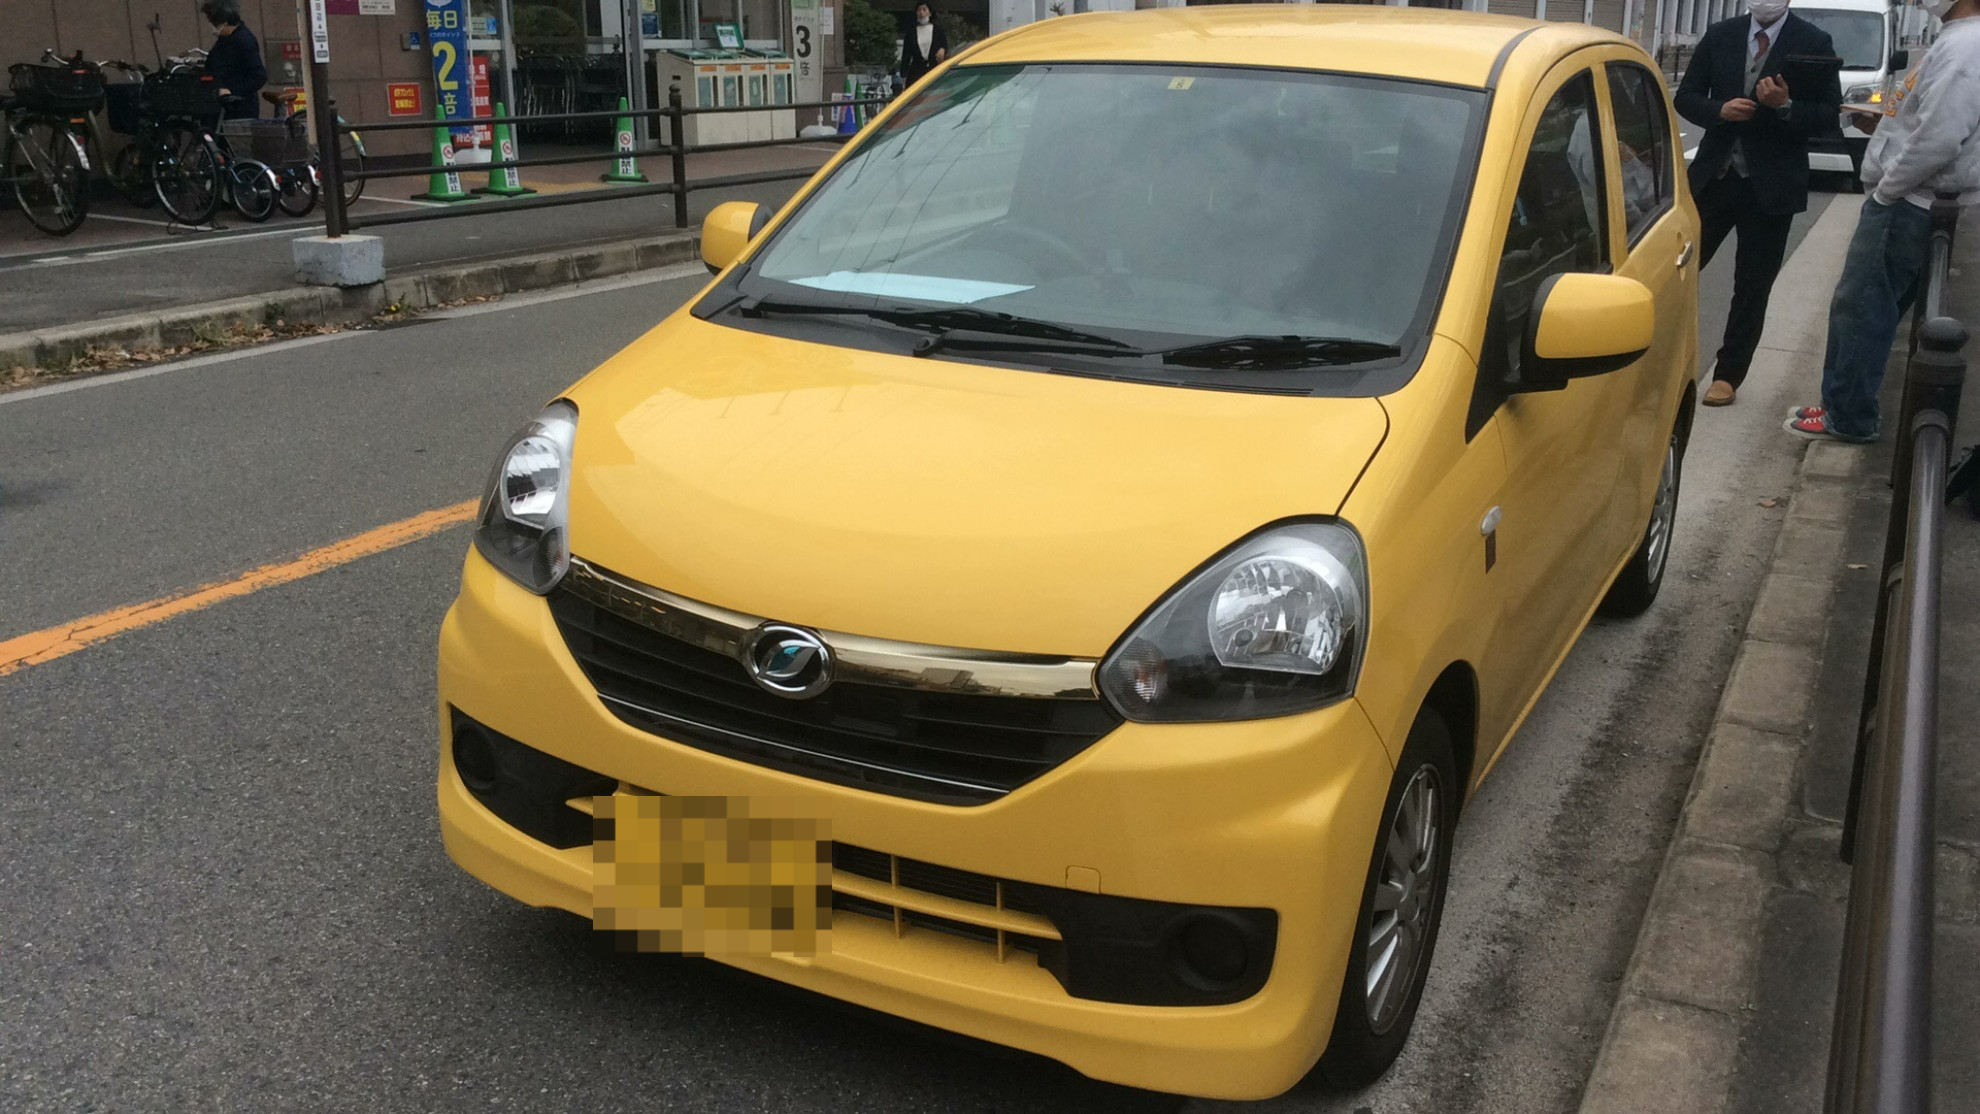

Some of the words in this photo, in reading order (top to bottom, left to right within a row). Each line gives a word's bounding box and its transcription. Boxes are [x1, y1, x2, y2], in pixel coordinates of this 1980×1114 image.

[426, 9, 458, 30] 毎日
[796, 25, 811, 58] 3
[432, 41, 458, 90] 2
